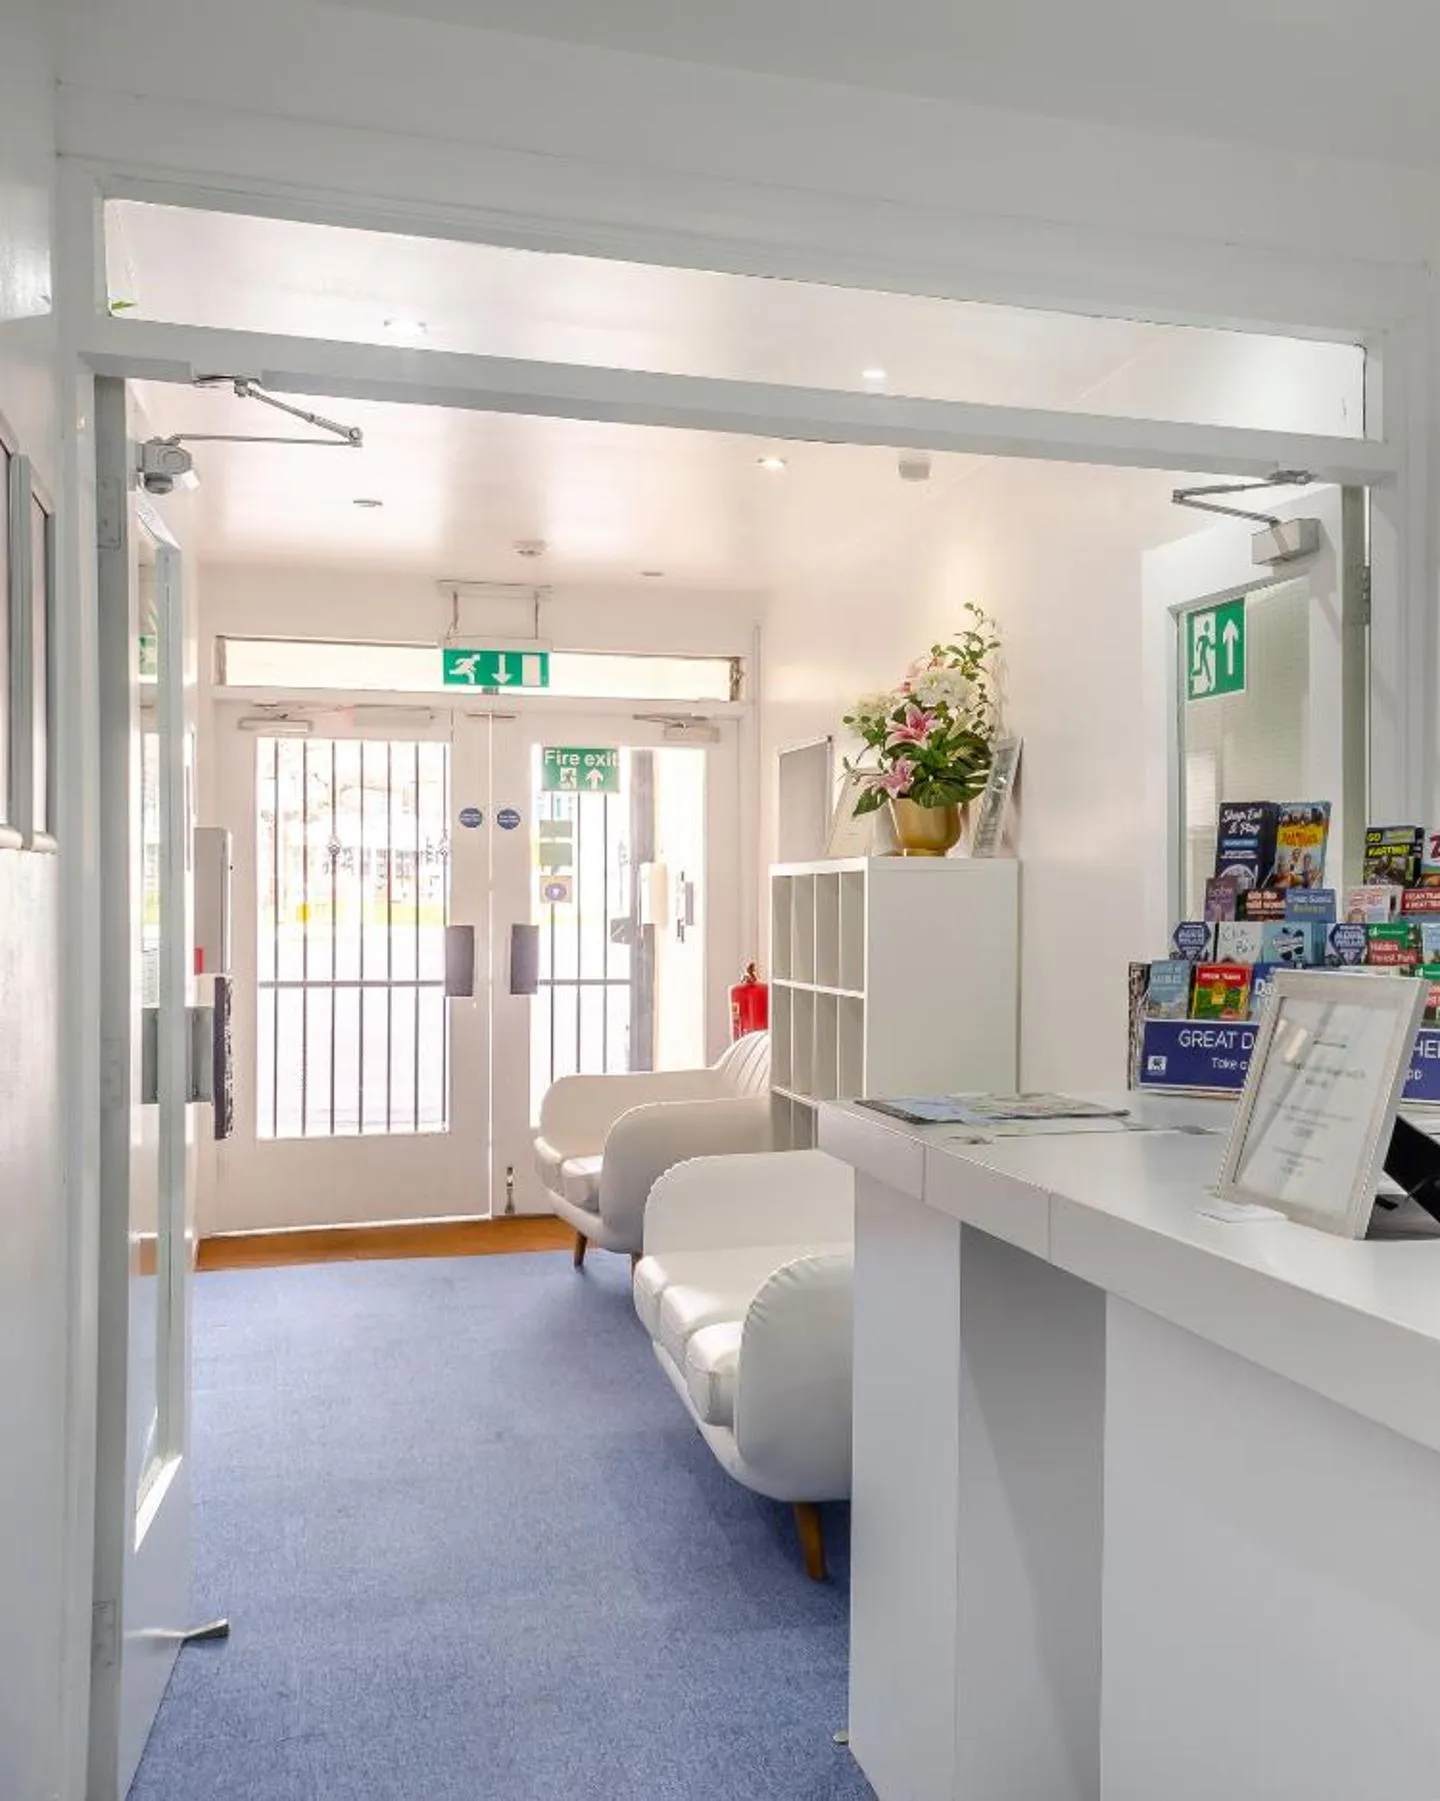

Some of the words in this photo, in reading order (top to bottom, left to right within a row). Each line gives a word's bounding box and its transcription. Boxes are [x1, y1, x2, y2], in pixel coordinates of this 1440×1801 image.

[544, 749, 580, 767] Fire
[584, 750, 618, 768] exit
[1367, 831, 1382, 842] GO
[1178, 1028, 1238, 1049] GREAT
[1211, 1057, 1238, 1070] Take
